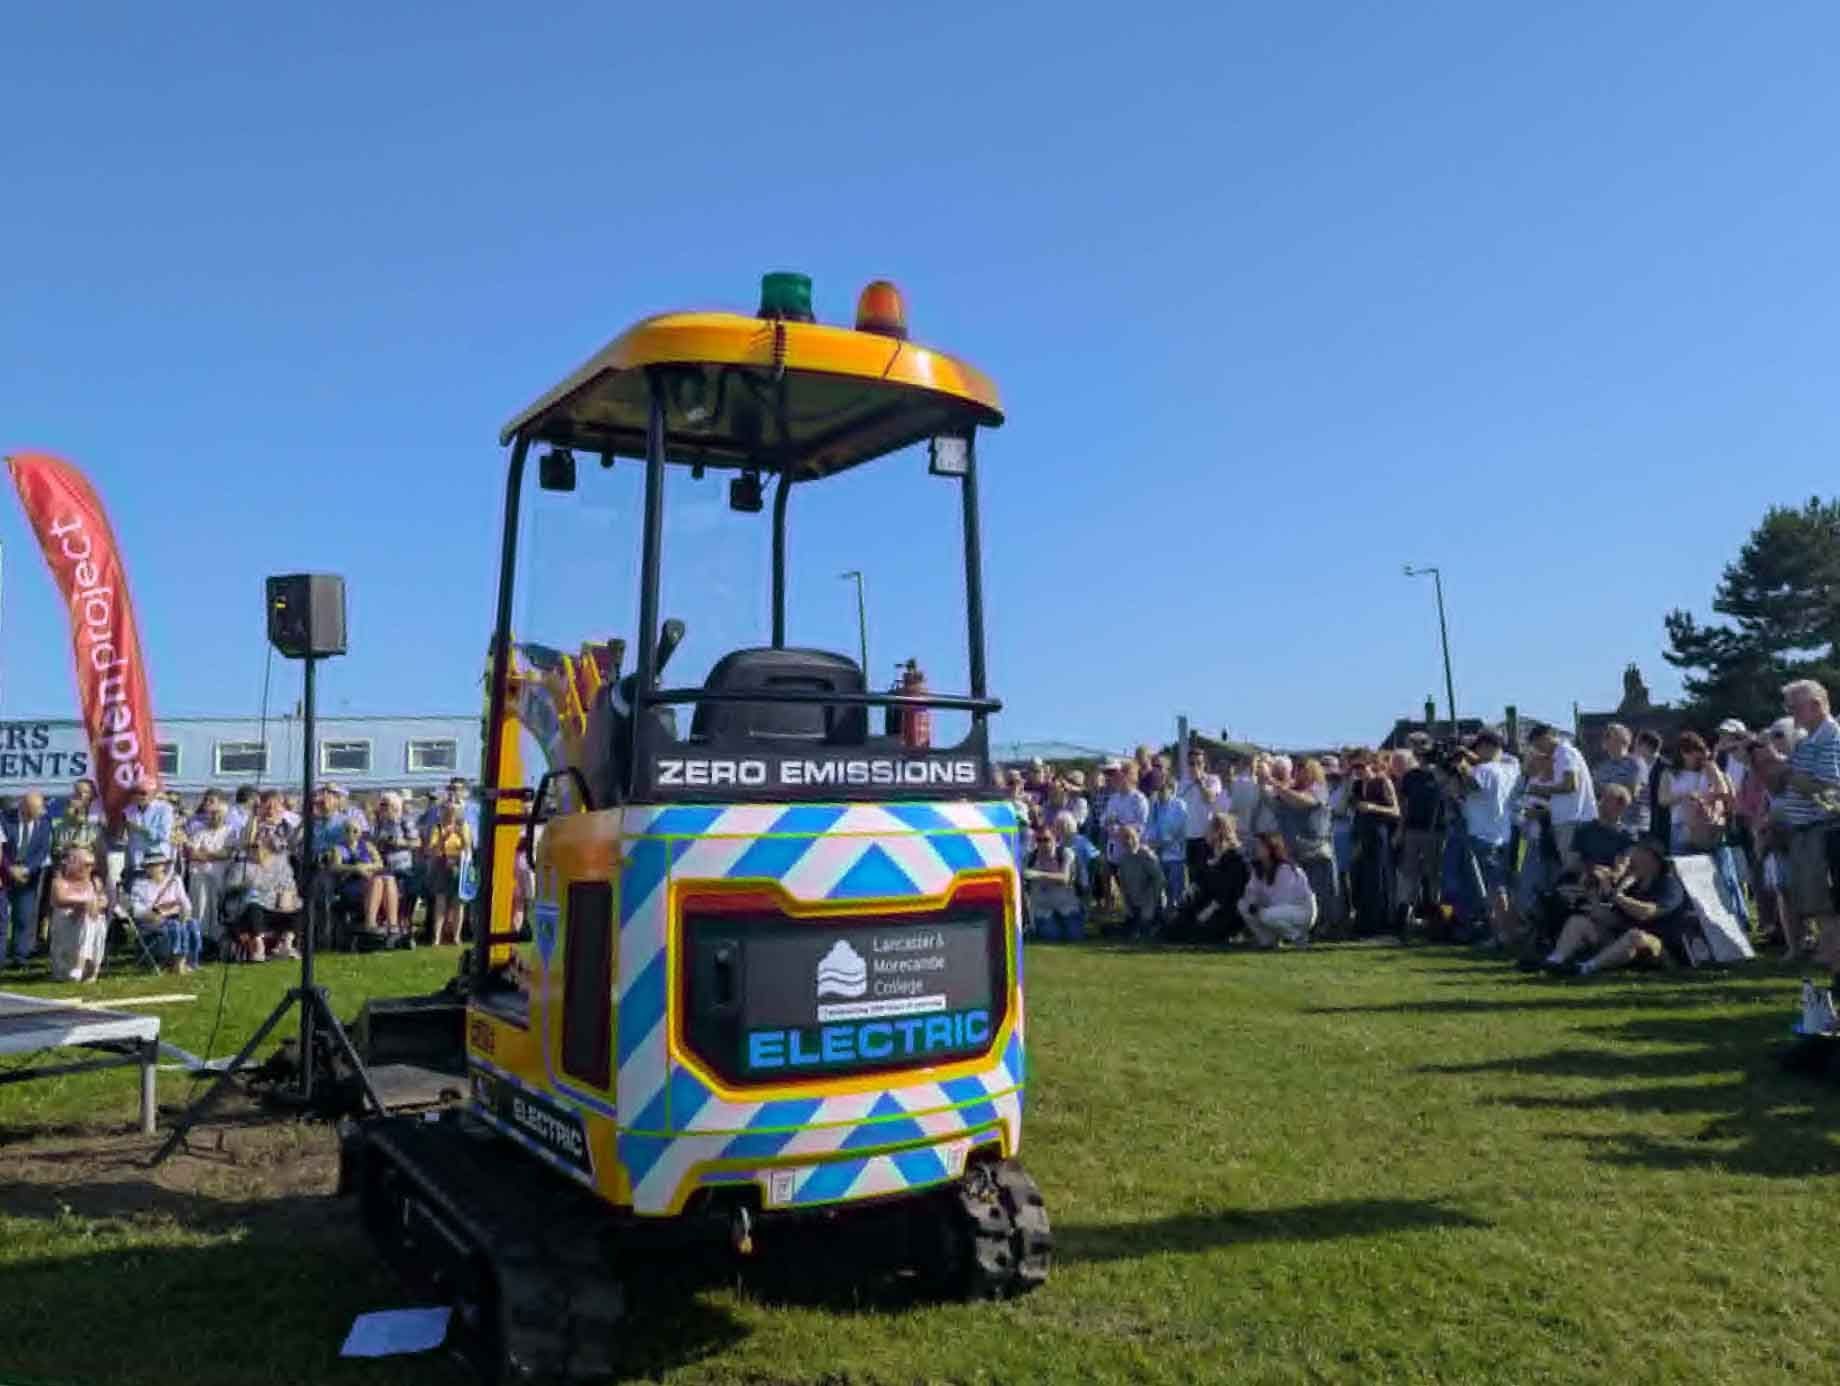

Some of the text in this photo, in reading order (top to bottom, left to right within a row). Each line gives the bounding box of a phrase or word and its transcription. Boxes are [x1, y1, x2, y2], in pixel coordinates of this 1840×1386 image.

[50, 514, 139, 790] eden project
[657, 760, 976, 785] ZERO EMISSIONS
[749, 1010, 990, 1068] ELECTRIC
[513, 1097, 583, 1156] ELECTRIC
